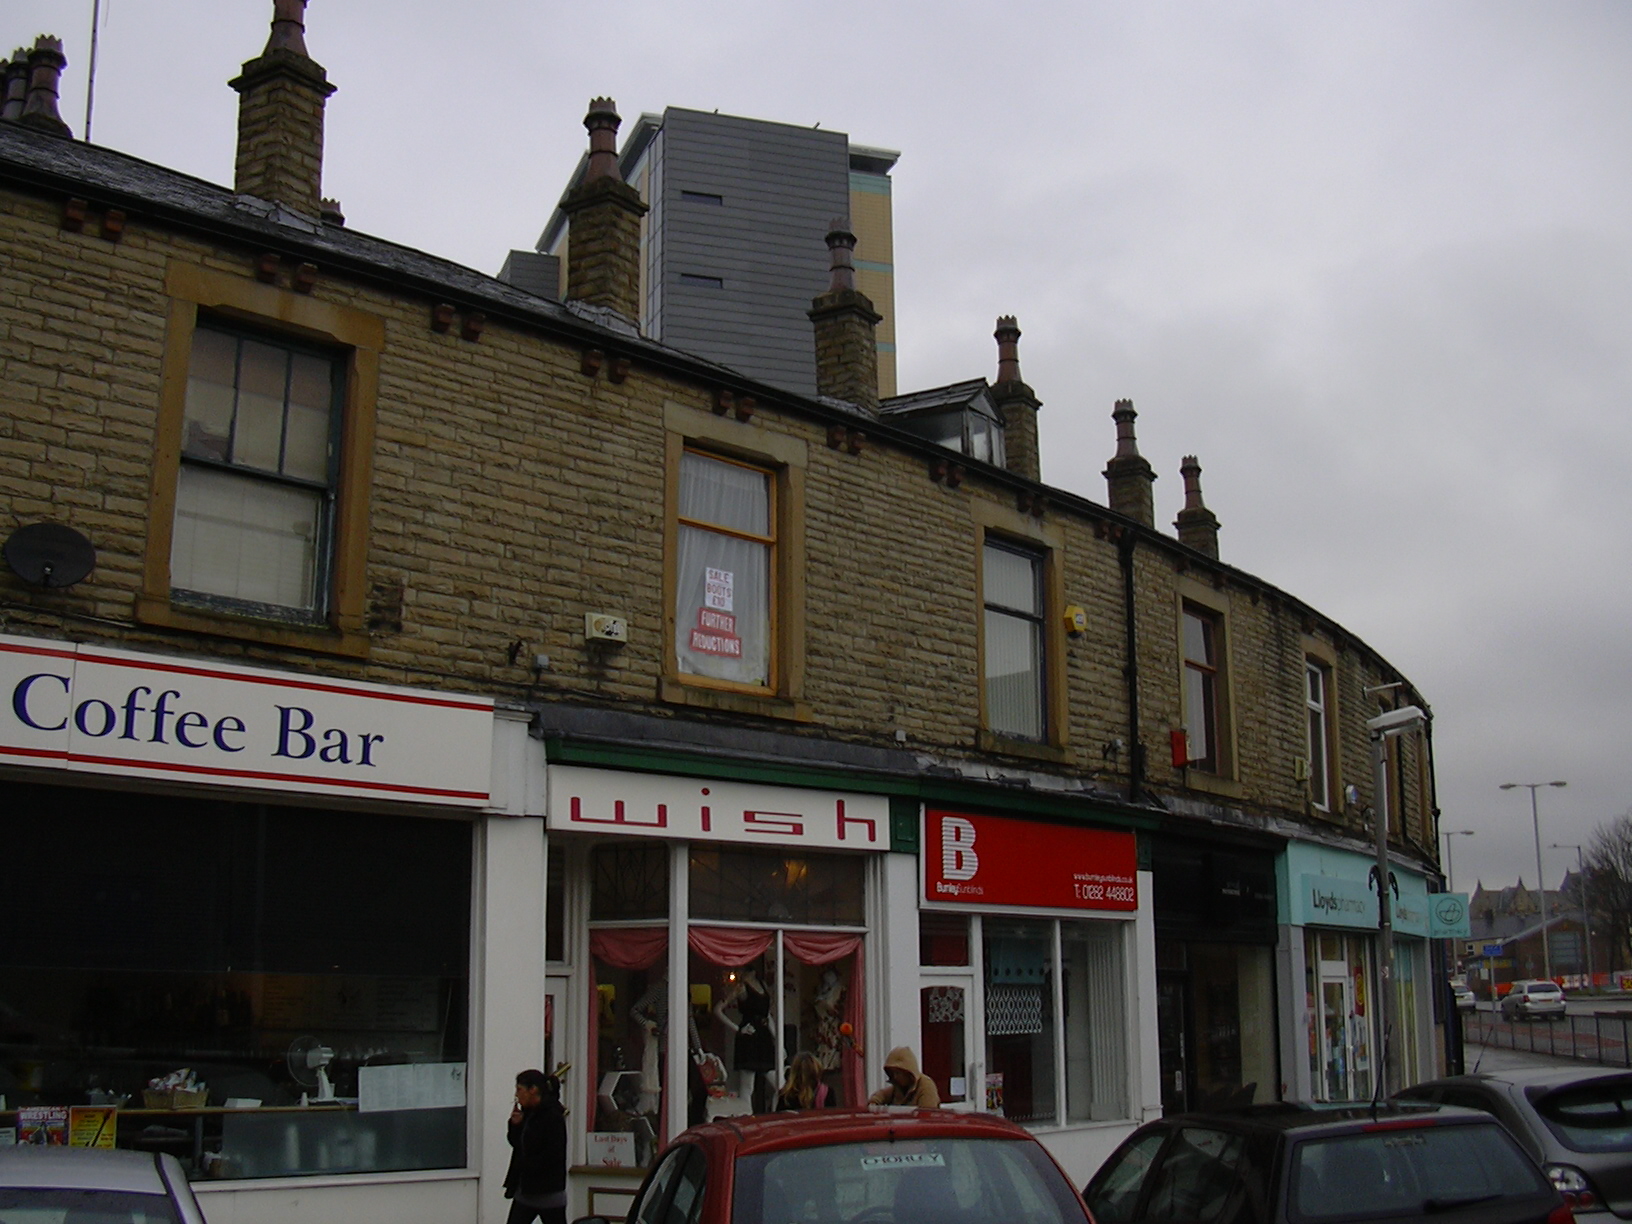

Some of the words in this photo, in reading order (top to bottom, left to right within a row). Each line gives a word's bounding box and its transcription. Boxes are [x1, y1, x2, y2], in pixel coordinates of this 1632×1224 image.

[706, 582, 732, 598] BOOTS
[709, 570, 730, 584] SALE
[11, 672, 247, 753] Coffee
[270, 704, 385, 768] Bar
[570, 787, 876, 843] wish
[941, 816, 979, 881] B
[20, 1110, 67, 1121] WRESTLING
